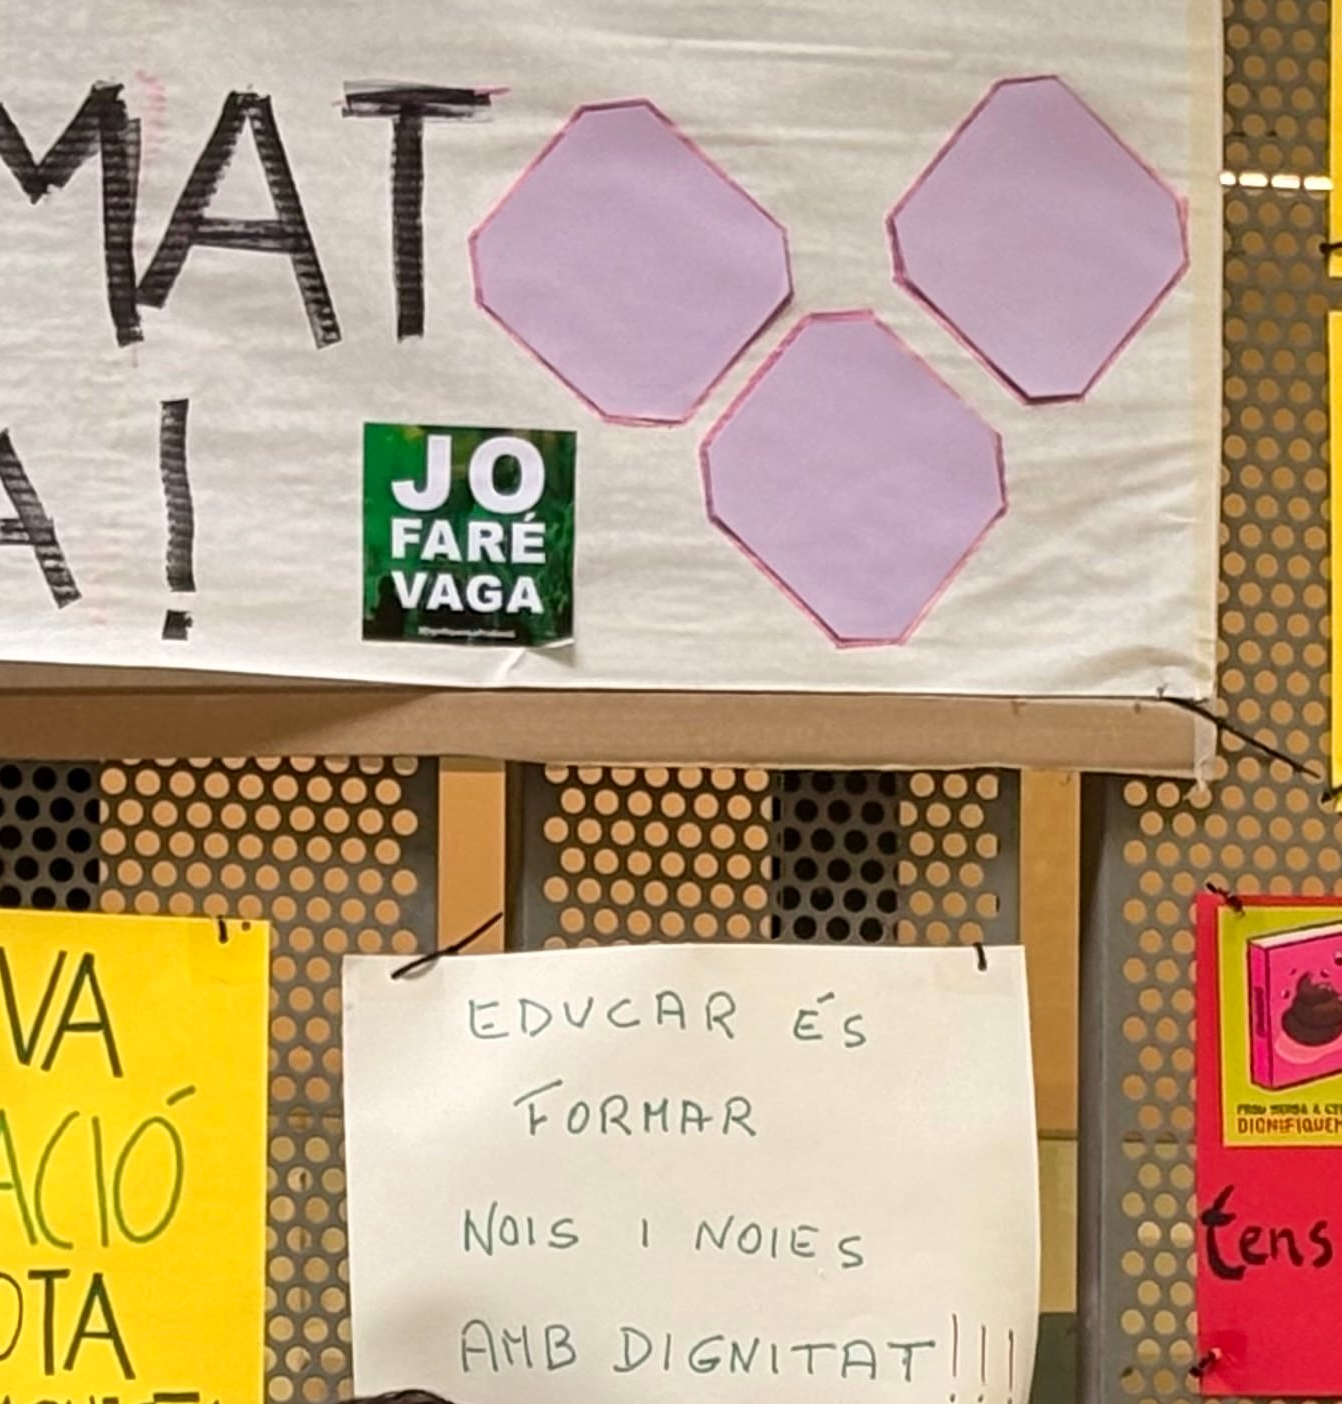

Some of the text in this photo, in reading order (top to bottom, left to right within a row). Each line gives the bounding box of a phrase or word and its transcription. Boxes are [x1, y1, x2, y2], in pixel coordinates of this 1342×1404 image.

[391, 435, 545, 514] JO
[391, 512, 546, 564] FARÉ
[390, 571, 544, 614] VAGA
[470, 990, 869, 1049] EDUCAR ÉS
[513, 1079, 759, 1137] FORMAR
[463, 1201, 581, 1257] NOIS
[694, 1215, 865, 1269] NOIES
[1201, 1184, 1335, 1280] tens
[461, 1319, 578, 1375] AMB
